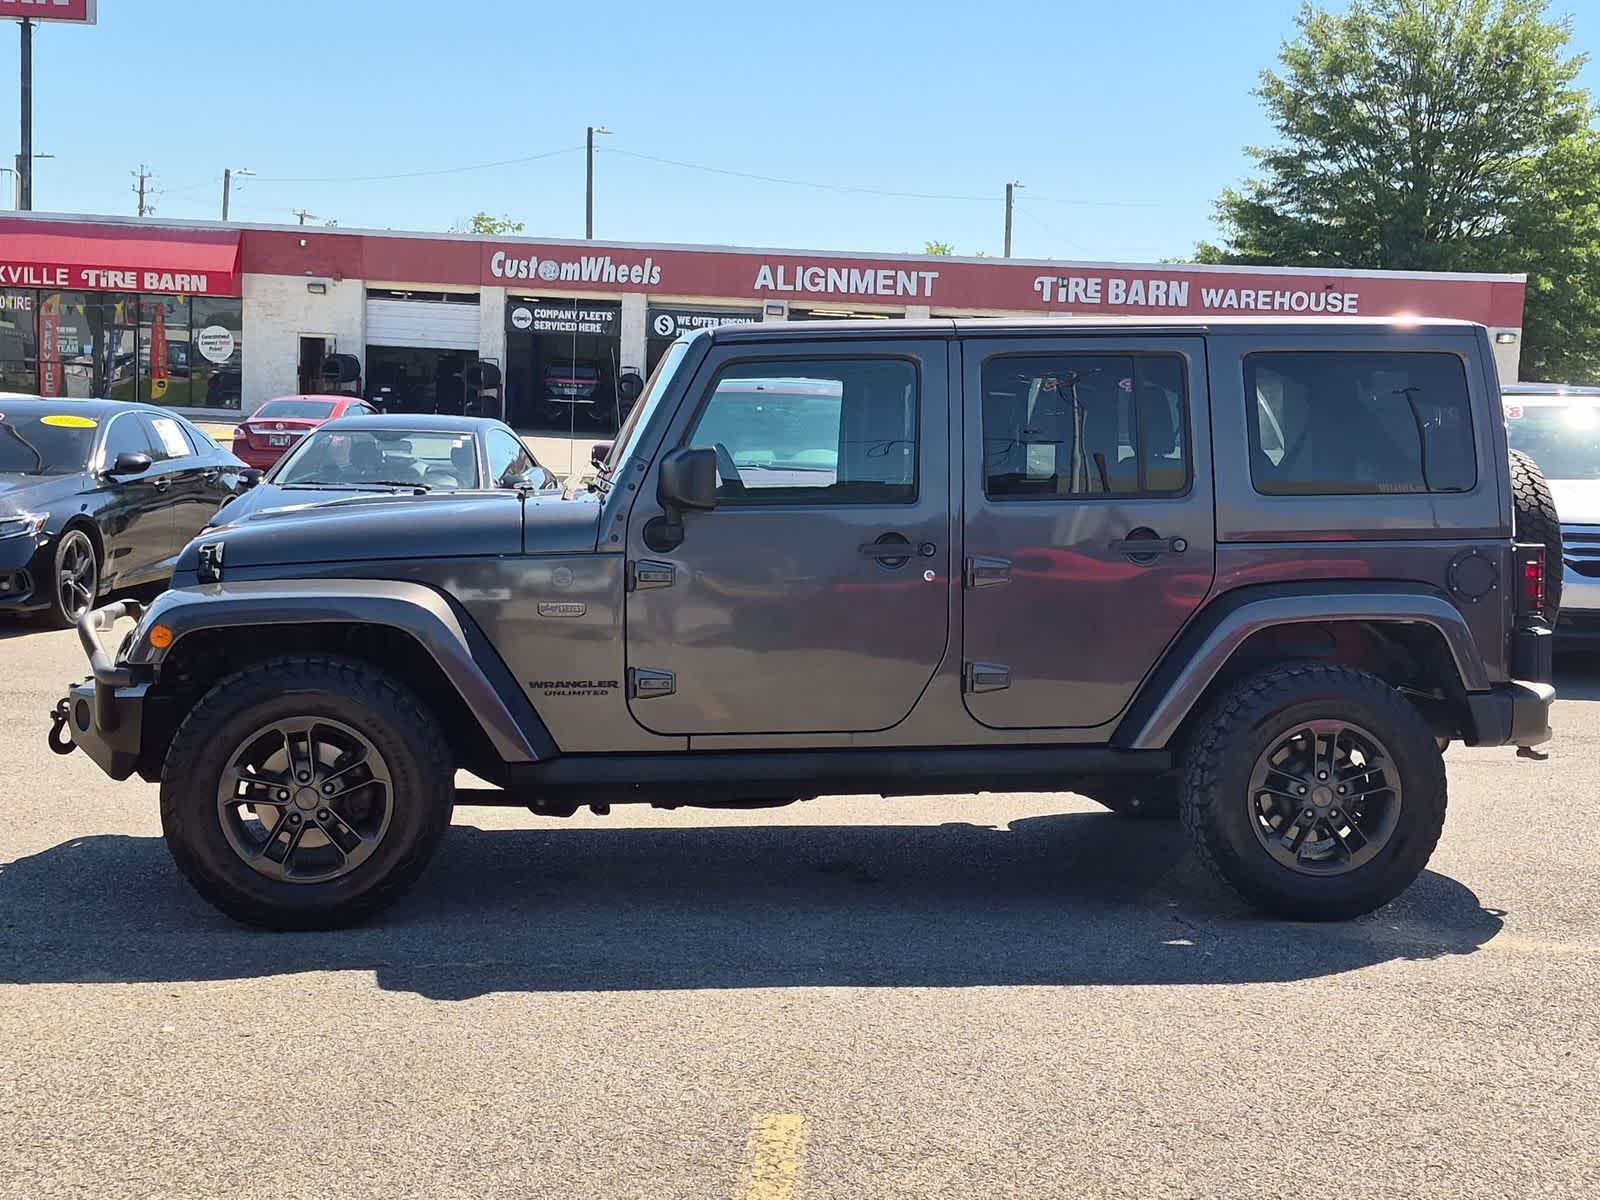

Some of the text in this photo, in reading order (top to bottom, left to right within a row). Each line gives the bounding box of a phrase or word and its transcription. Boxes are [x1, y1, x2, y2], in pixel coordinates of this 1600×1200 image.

[144, 272, 207, 292] BARN
[754, 265, 939, 297] ALIGNMENT
[1108, 279, 1189, 307] BARN
[1201, 287, 1358, 314] WAREHOUSE
[534, 309, 613, 321] COMPANY FLEETS
[676, 315, 691, 326] WE
[692, 316, 719, 328] OFFER
[534, 322, 602, 333] SERVICED HERE
[44, 320, 54, 393] SERVICE
[529, 681, 619, 689] WRANGLER
